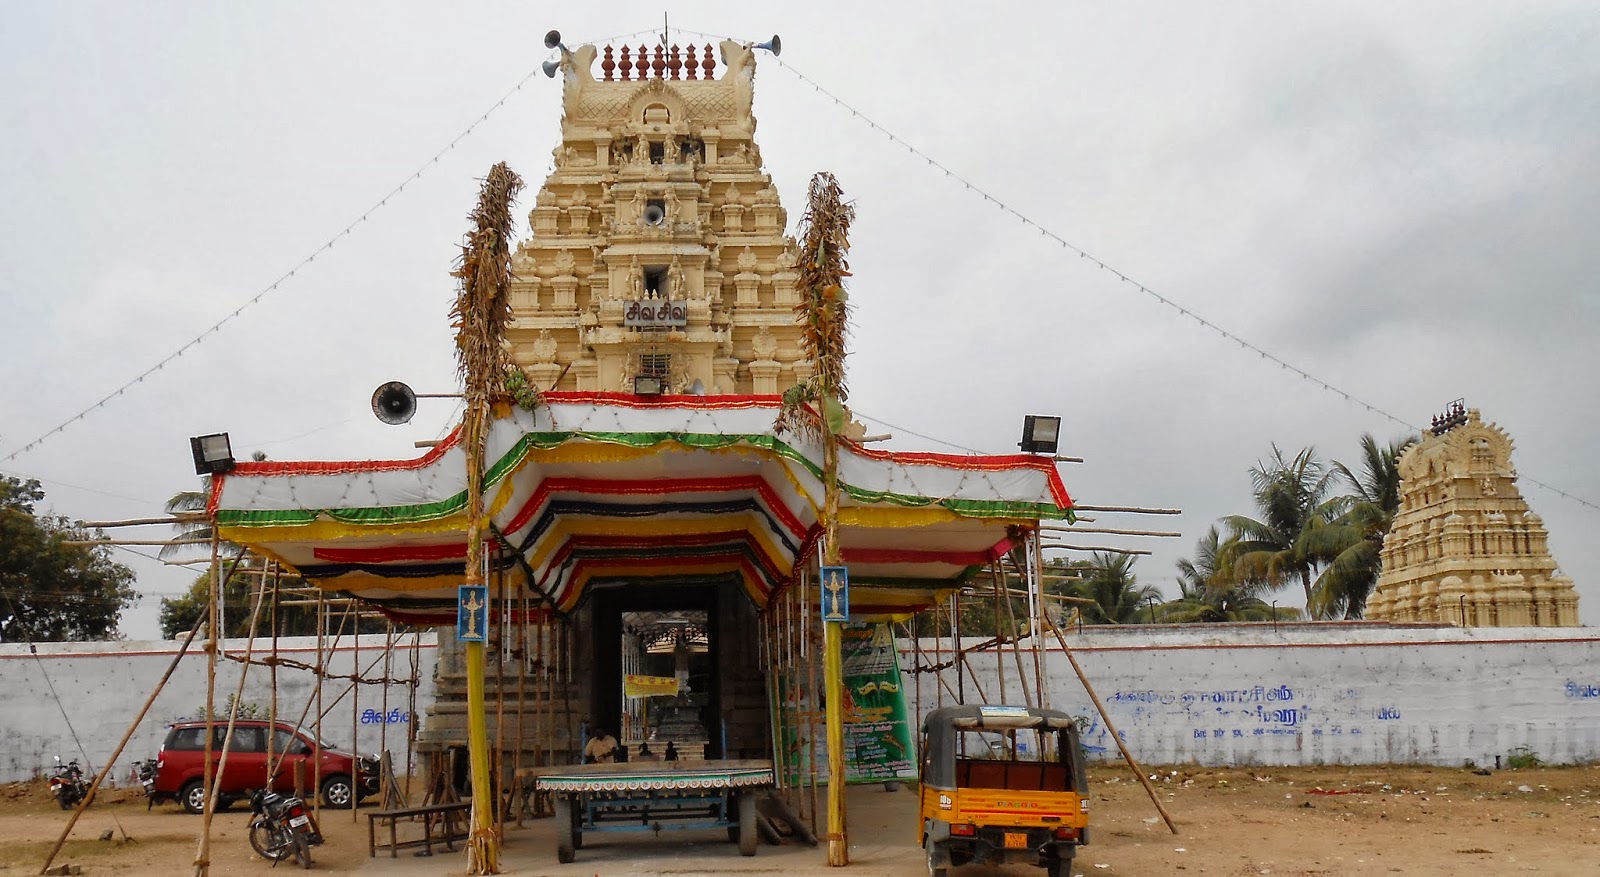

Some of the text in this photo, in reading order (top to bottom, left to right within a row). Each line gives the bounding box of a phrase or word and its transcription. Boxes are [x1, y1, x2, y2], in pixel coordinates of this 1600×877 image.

[626, 302, 686, 320] சிவ சிவ
[997, 801, 1039, 809] PIAGGIO
